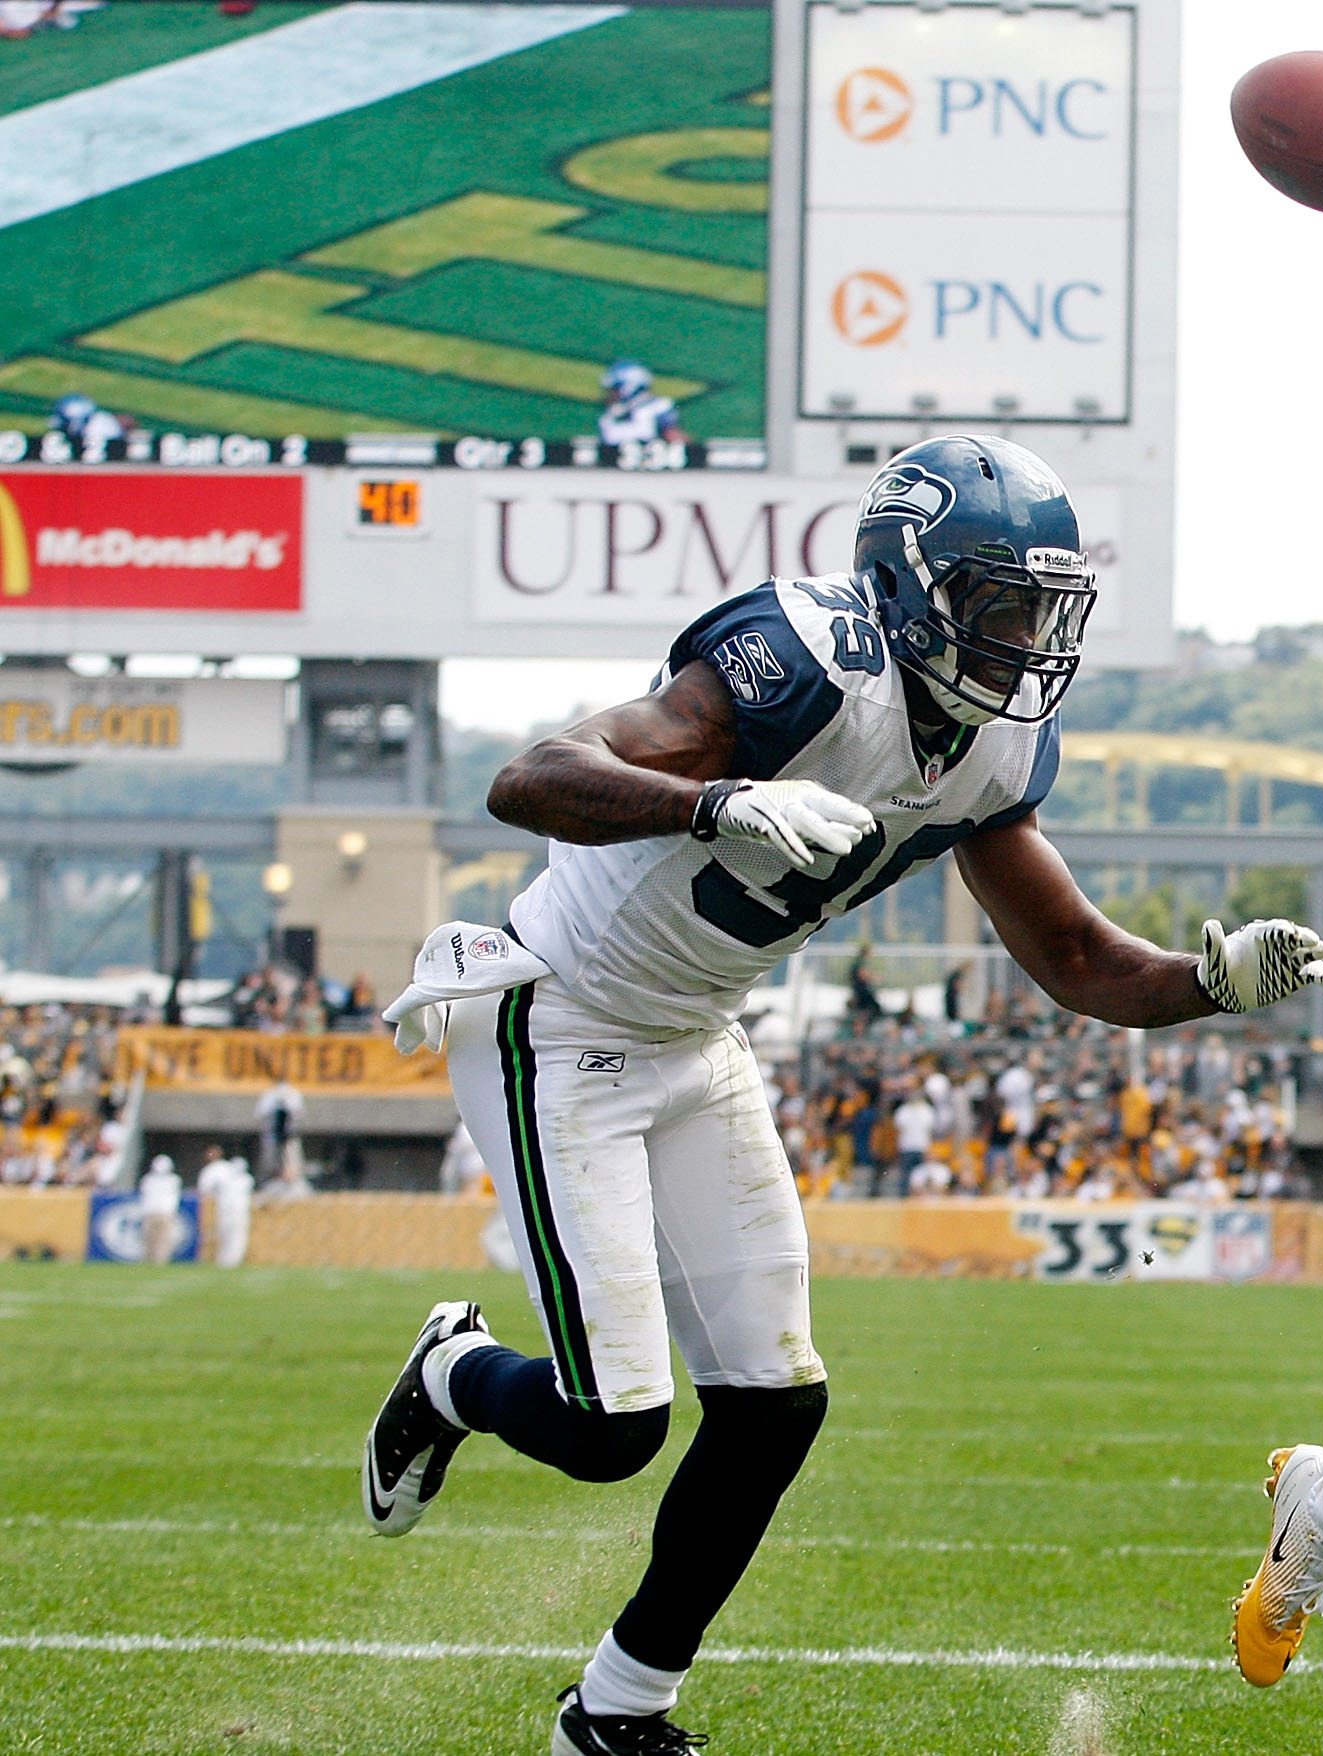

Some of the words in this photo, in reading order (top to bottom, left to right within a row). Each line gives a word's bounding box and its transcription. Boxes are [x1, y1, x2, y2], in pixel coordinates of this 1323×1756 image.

[932, 76, 1107, 142] PNC
[928, 279, 1104, 344] PNC
[221, 435, 270, 466] On
[282, 434, 307, 466] 2
[454, 436, 510, 469] Qtr
[520, 437, 545, 469] 3
[358, 482, 419, 524] 40
[37, 529, 284, 569] McDonald's
[451, 932, 465, 980] Wilson
[223, 1043, 365, 1083] UNITED
[1046, 1221, 1131, 1274] 33
